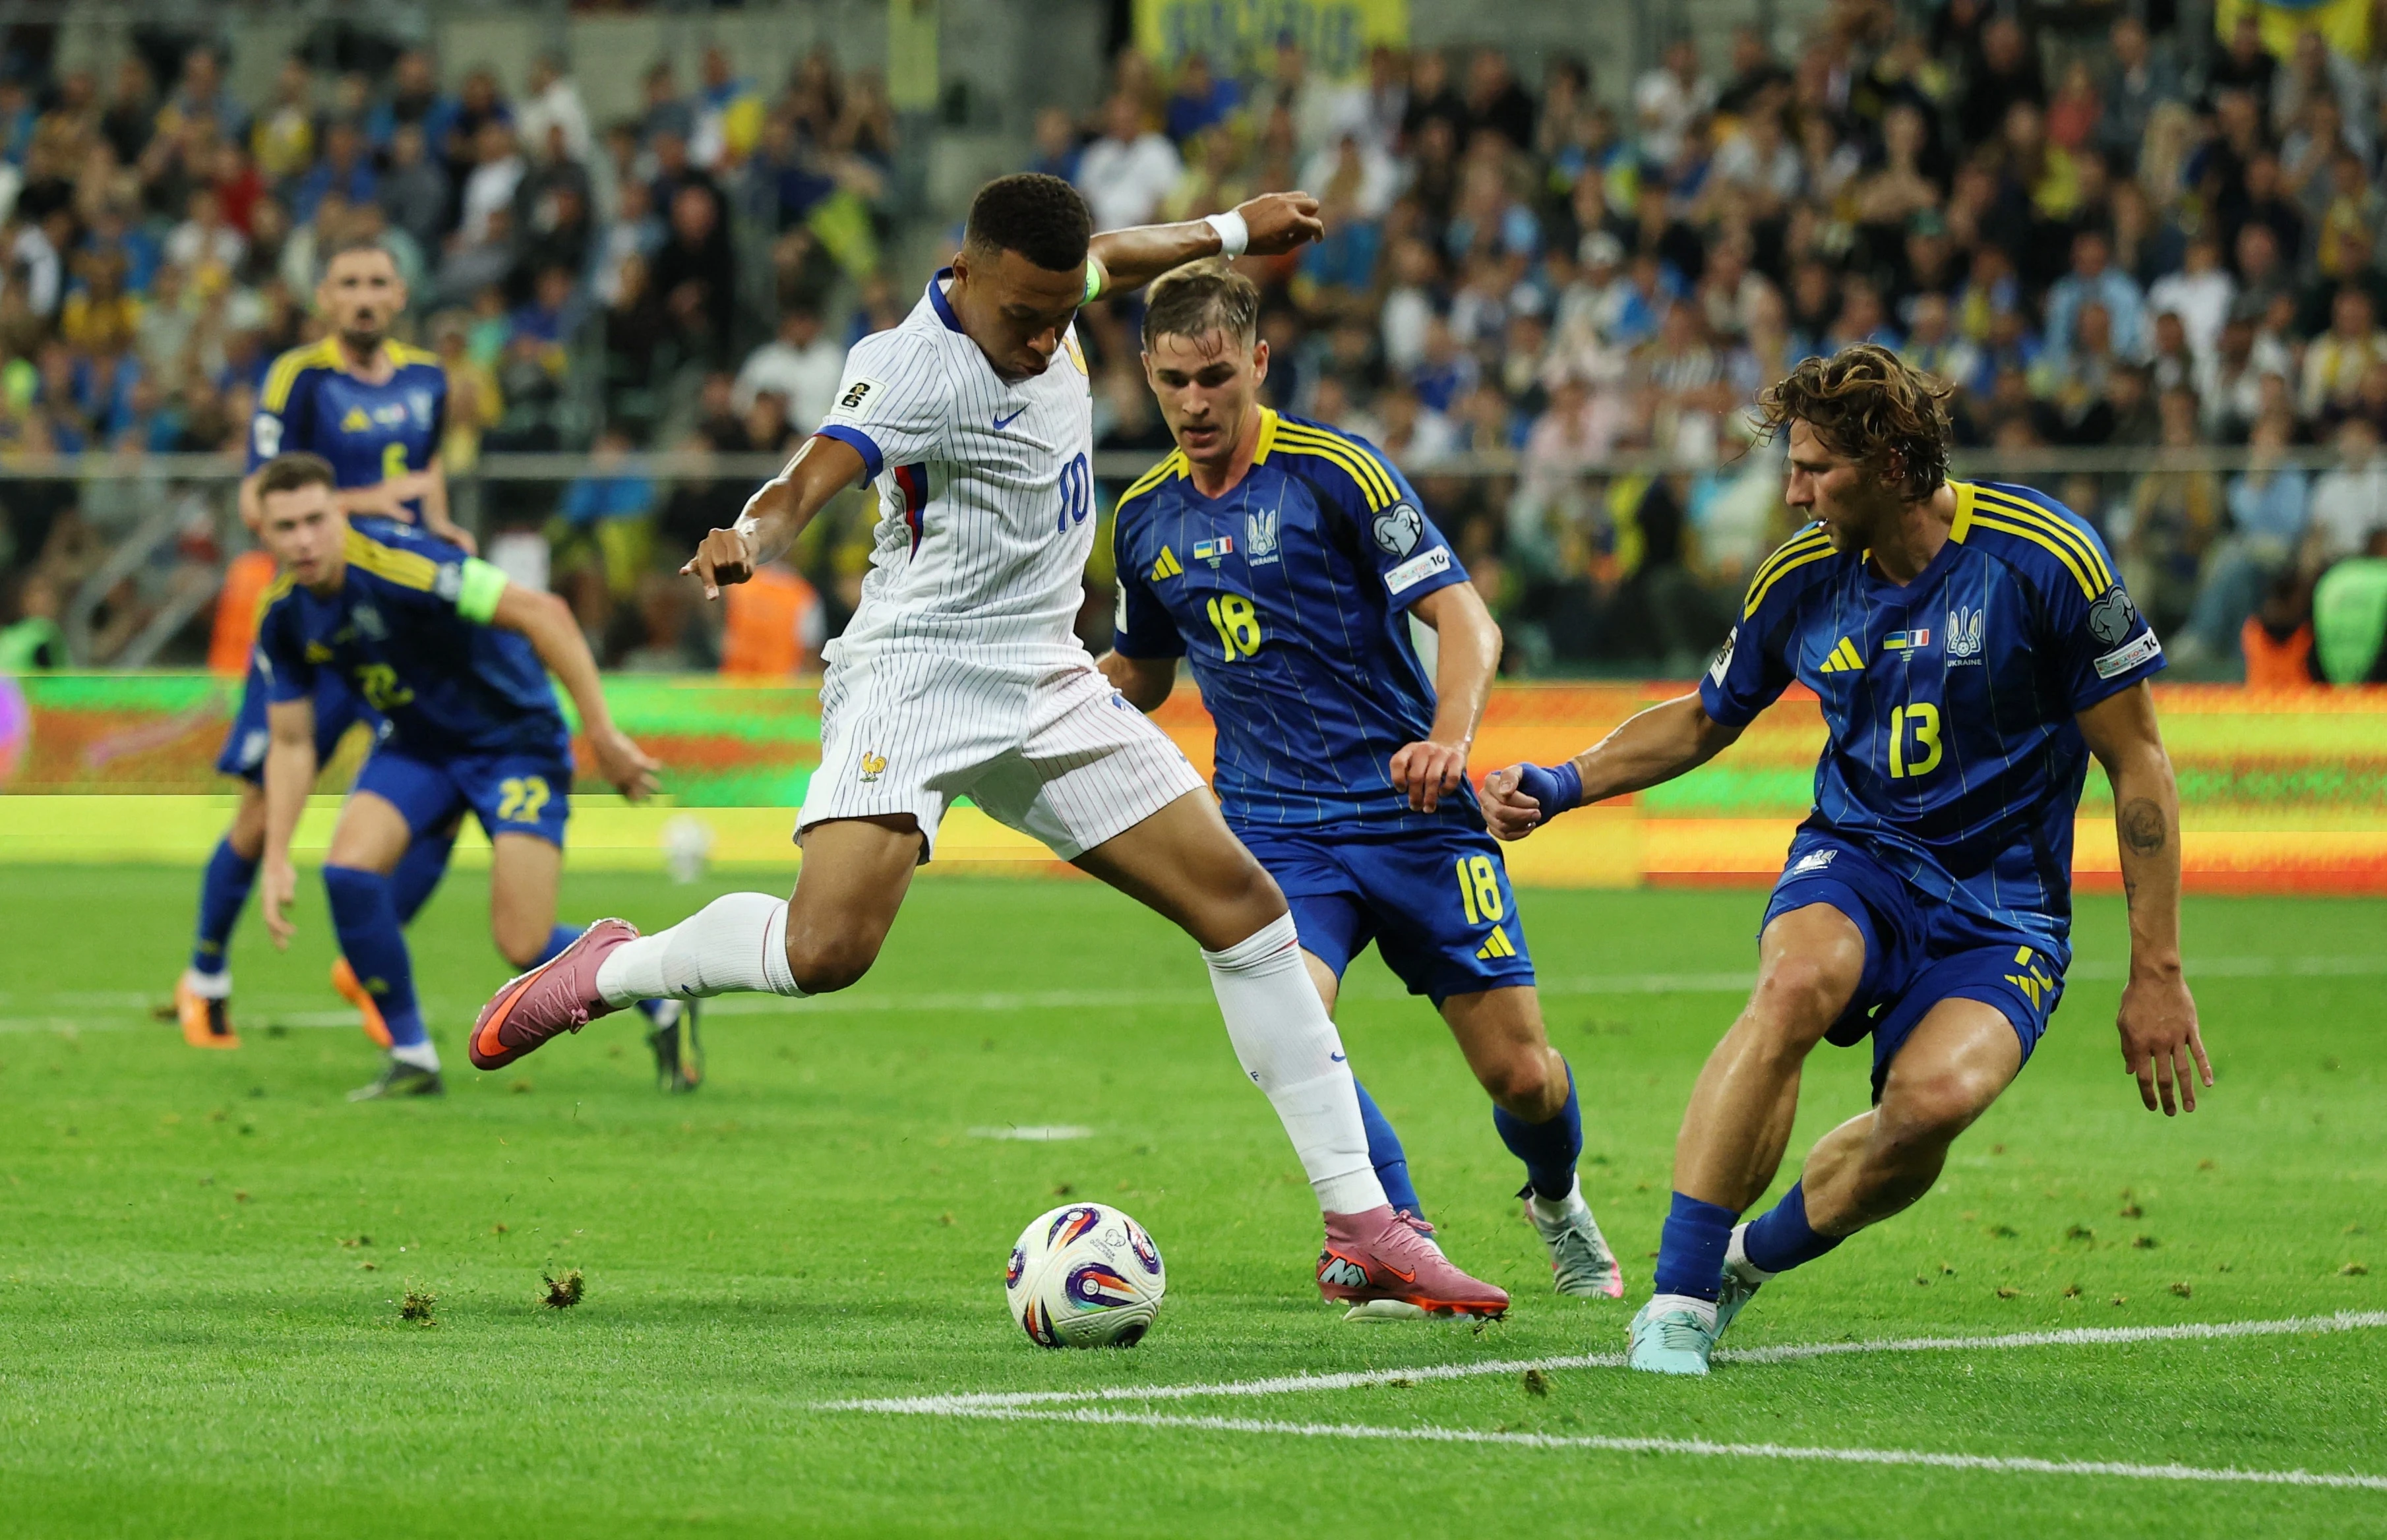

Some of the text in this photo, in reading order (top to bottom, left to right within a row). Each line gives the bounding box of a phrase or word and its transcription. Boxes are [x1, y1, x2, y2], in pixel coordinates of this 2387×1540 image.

[1056, 452, 1089, 535] 10
[1249, 554, 1279, 567] UKRAINE
[1206, 594, 1261, 662] 18
[1947, 659, 1982, 667] UKRAINE
[1889, 703, 1942, 778] 13
[1456, 856, 1503, 924] 18
